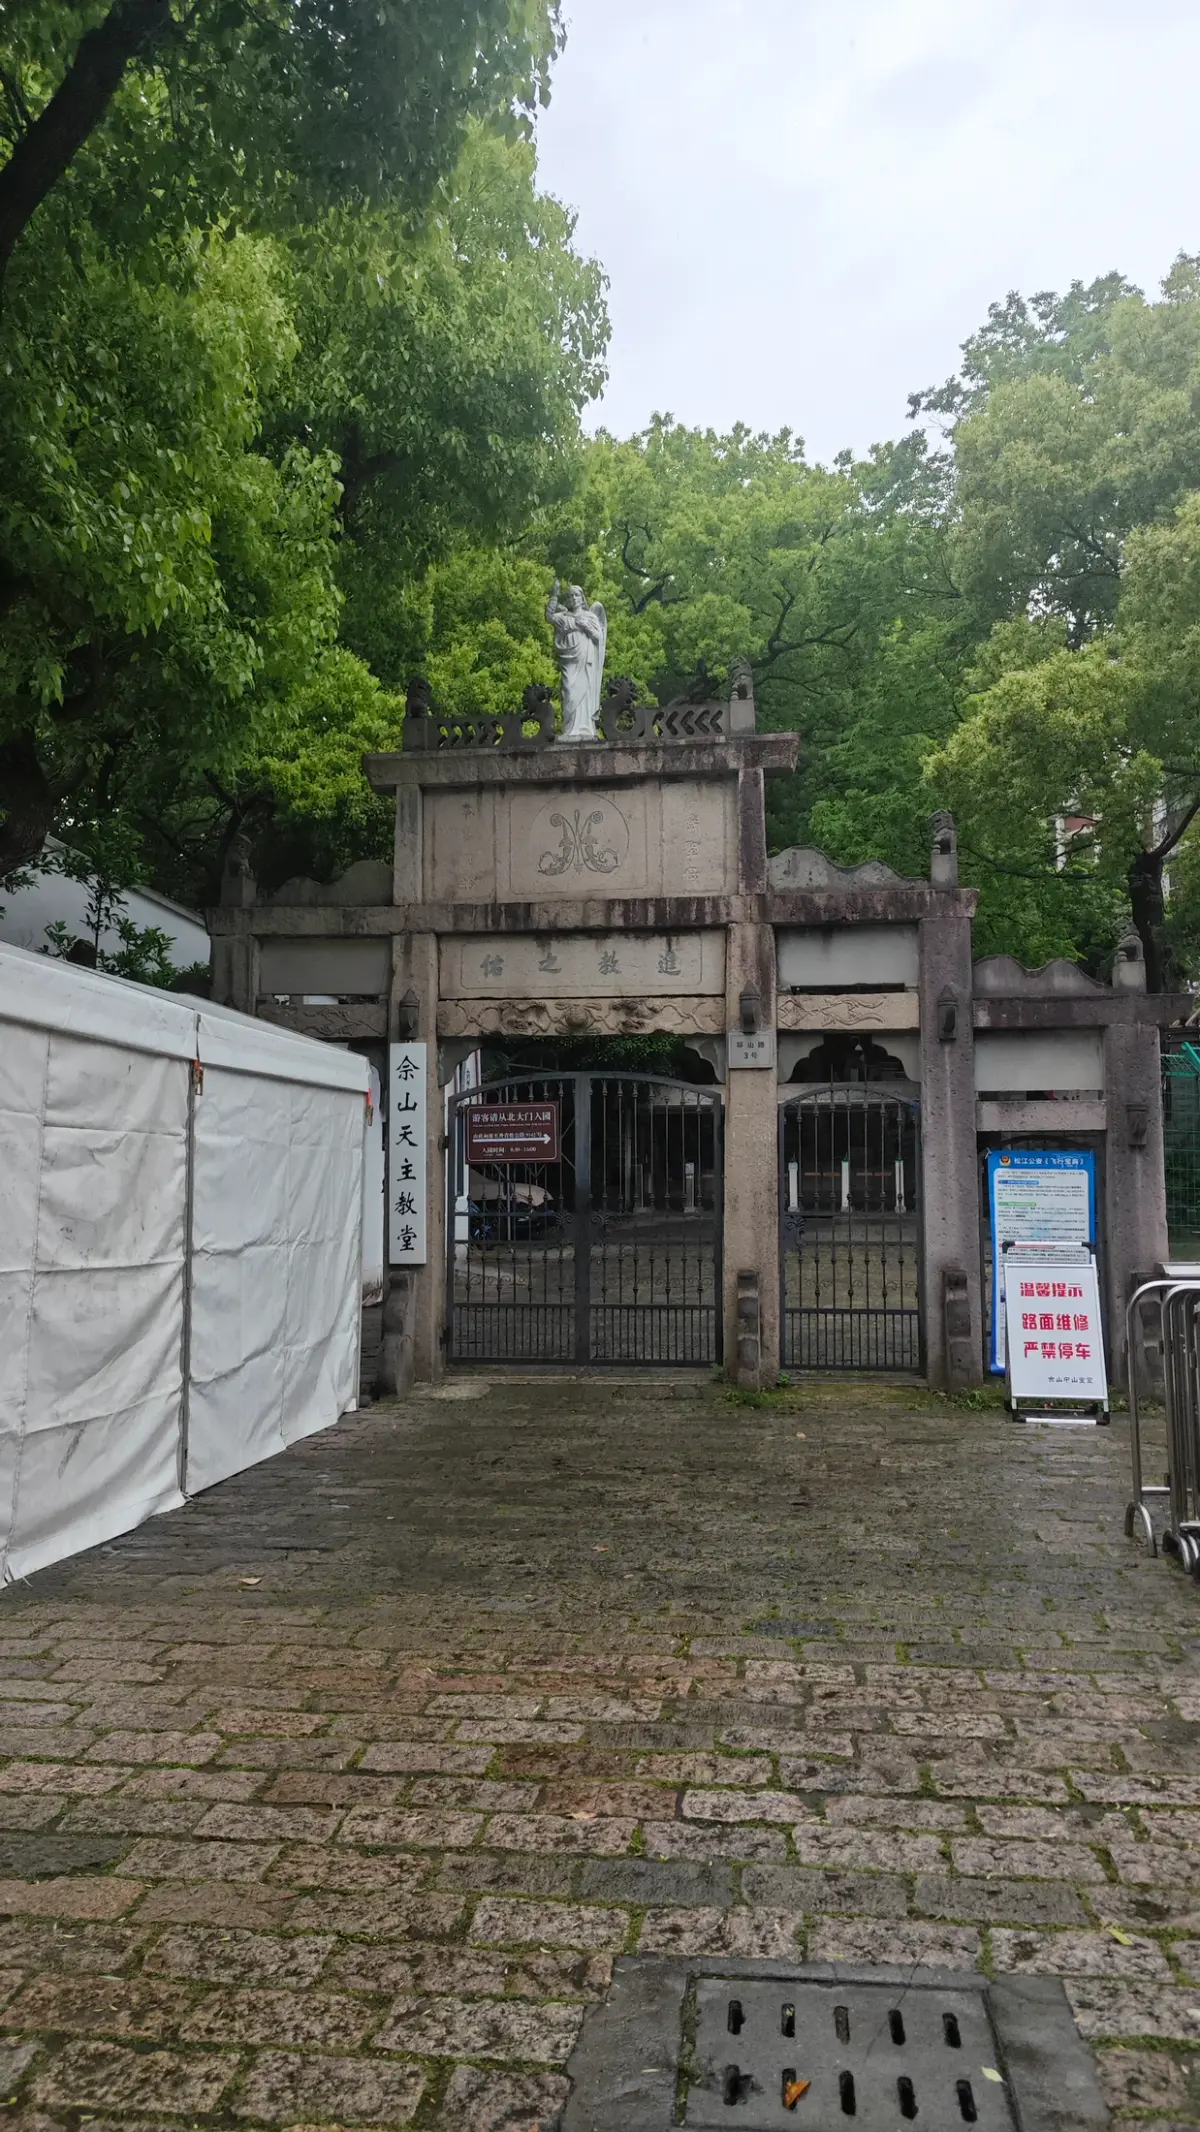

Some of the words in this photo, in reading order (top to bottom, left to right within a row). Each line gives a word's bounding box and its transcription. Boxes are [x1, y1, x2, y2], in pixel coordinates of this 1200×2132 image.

[394, 1055, 420, 1251] 佘山天主教堂
[1020, 1282, 1083, 1298] 温馨提示
[1021, 1313, 1089, 1331] 路面维修
[1023, 1341, 1091, 1359] 严禁停车
